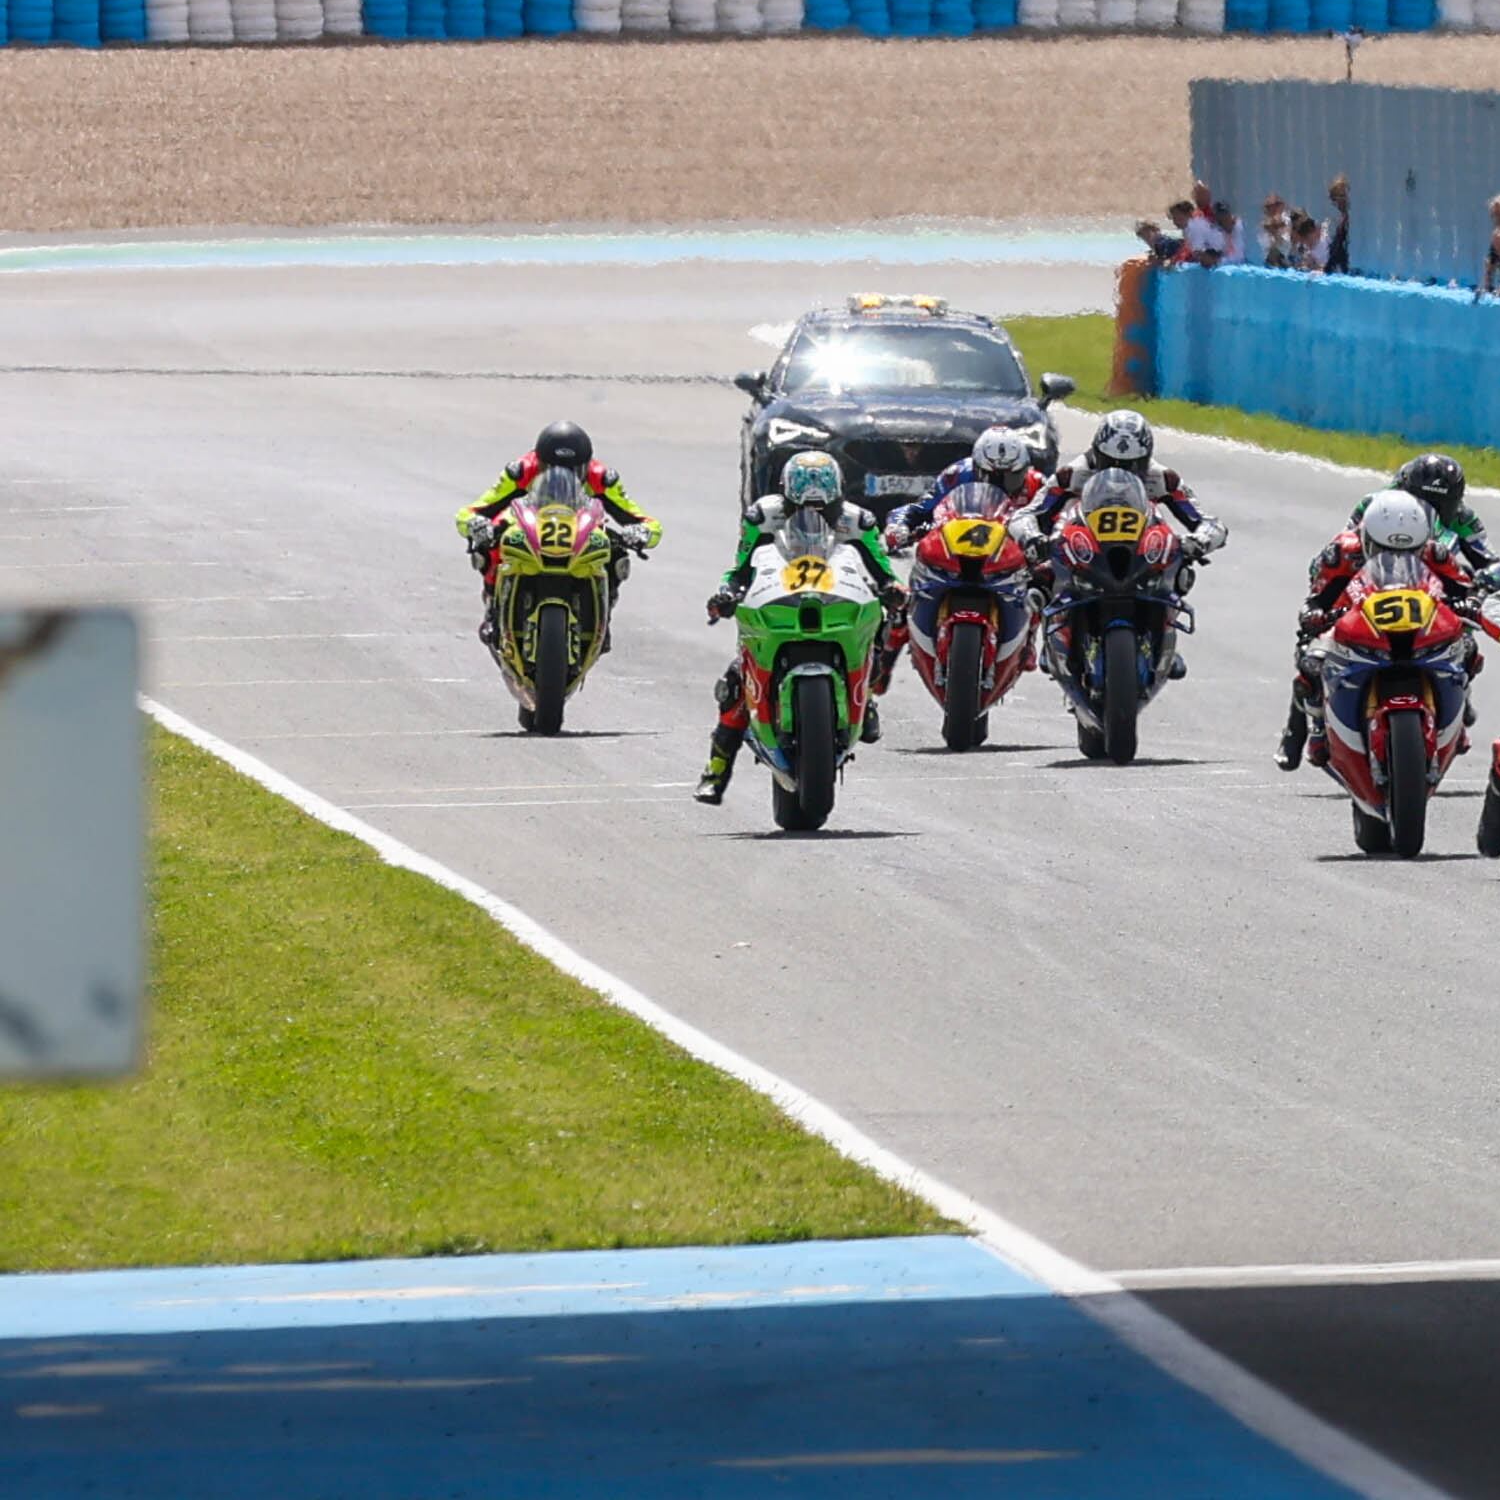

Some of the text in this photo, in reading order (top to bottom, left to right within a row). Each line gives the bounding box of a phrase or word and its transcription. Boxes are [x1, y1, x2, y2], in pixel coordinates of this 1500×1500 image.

[540, 520, 573, 548] 22
[956, 523, 994, 548] 4
[1098, 512, 1139, 534] 82
[790, 560, 826, 589] 37
[1373, 596, 1423, 625] 51
